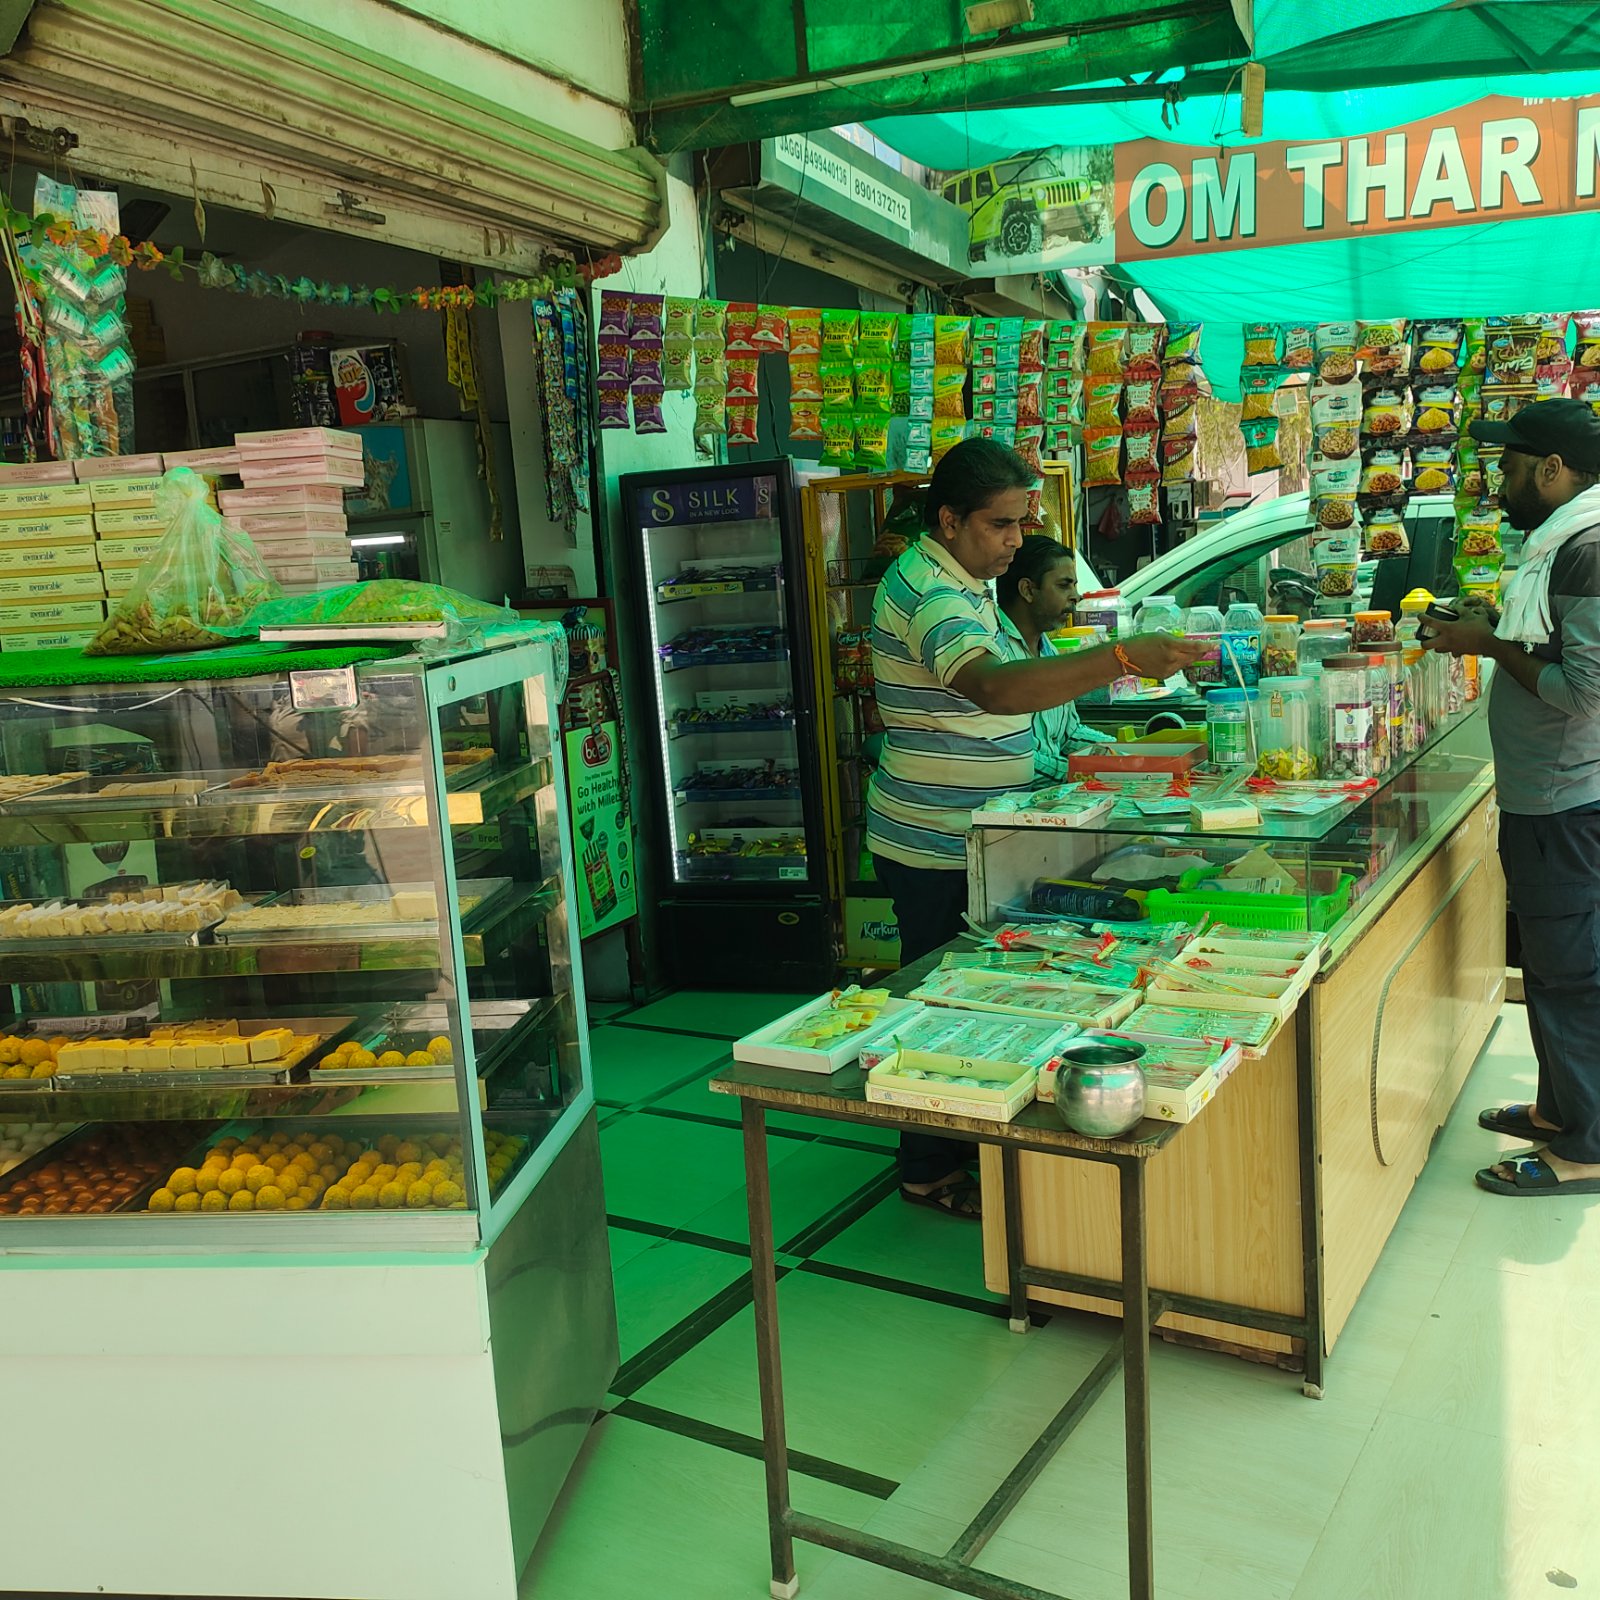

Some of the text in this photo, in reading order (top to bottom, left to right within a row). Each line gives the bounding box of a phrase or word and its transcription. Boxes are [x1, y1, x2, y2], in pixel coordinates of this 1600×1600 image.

[1129, 152, 1256, 247] OM
[1286, 117, 1543, 229] THAR
[855, 178, 907, 221] 8901372712
[1168, 402, 1188, 418] BHUJIA
[859, 438, 883, 446] itaara
[1168, 447, 1188, 463] BHUJIA
[688, 488, 740, 509] SILK
[29, 581, 62, 592] memorable
[30, 608, 62, 619] memorable
[37, 636, 70, 646] memorable
[577, 775, 621, 798] Go Healthy
[577, 792, 622, 815] with Millets
[863, 921, 900, 940] Kurkur
[959, 1059, 973, 1069] 30
